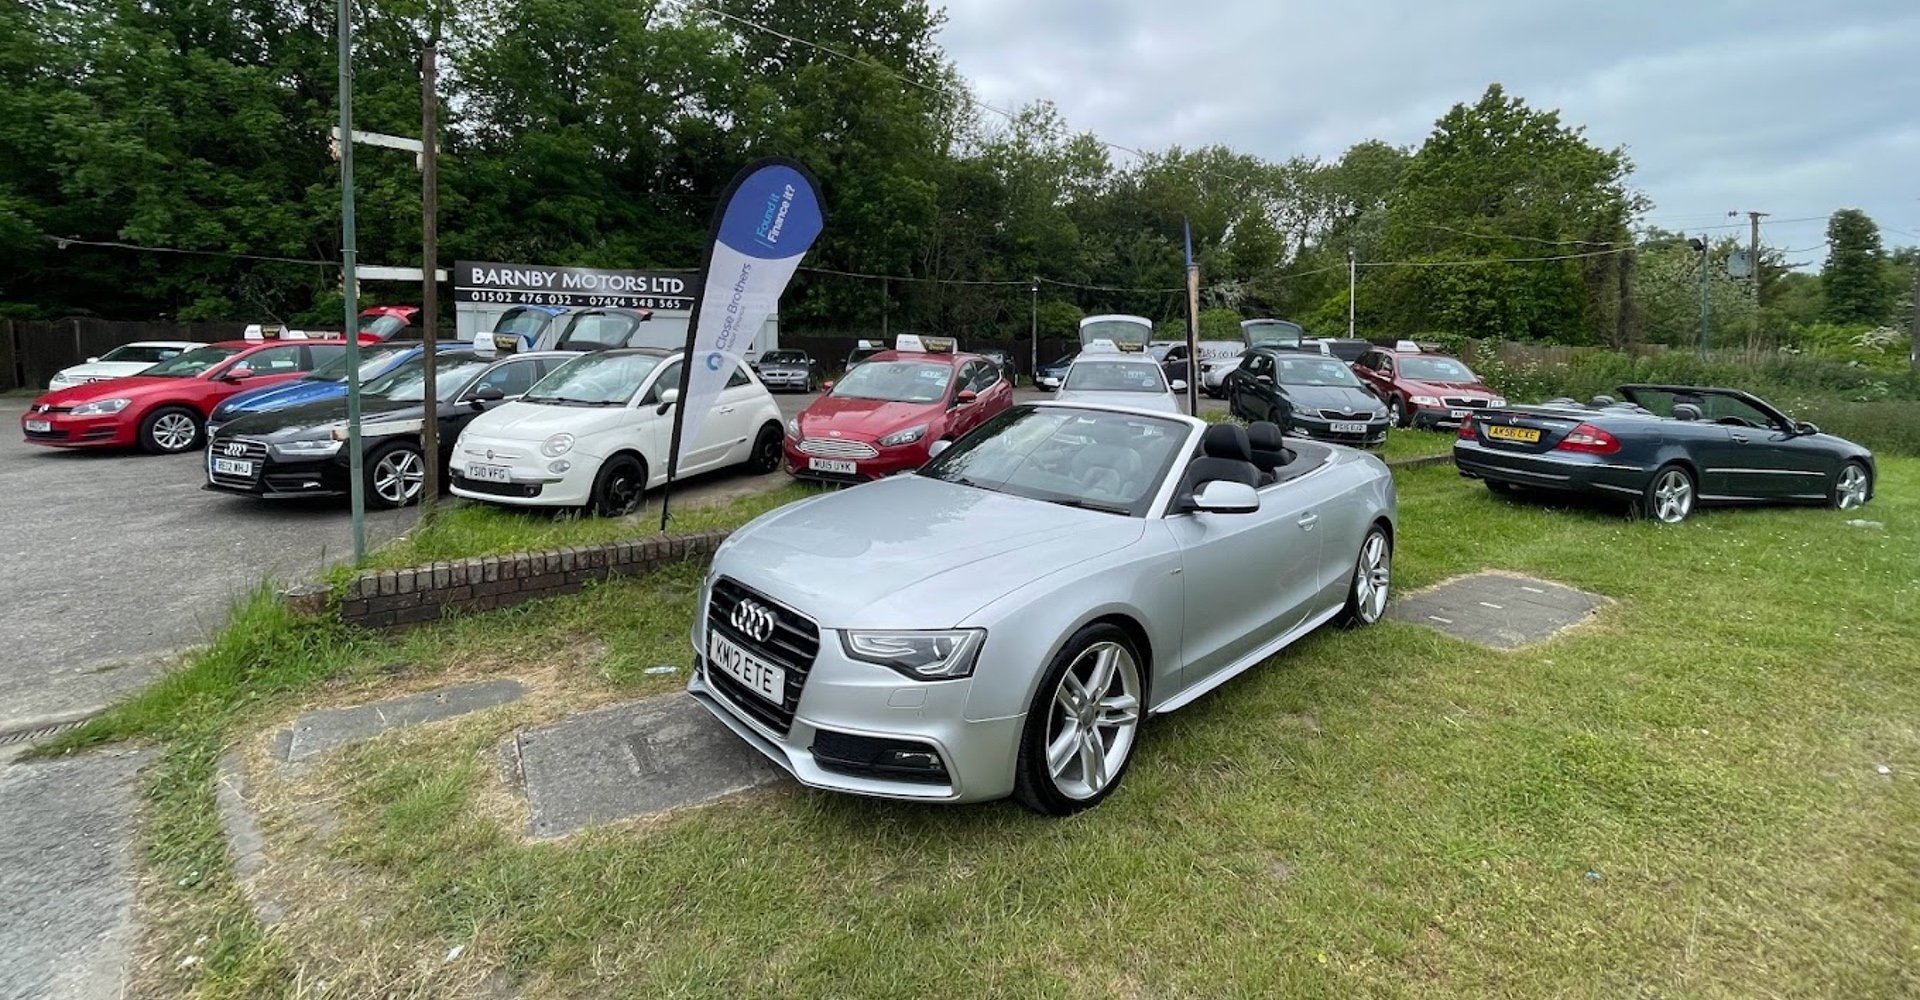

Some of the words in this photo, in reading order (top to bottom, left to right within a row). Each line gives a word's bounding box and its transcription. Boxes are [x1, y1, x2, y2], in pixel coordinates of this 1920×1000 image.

[756, 201, 776, 237] Found
[769, 193, 780, 202] it
[767, 201, 790, 243] Finance
[782, 184, 796, 201] it?
[471, 267, 557, 287] BARNBY
[562, 272, 648, 292] MOTORS
[652, 277, 685, 294] LTD
[471, 291, 512, 303] 01502
[519, 293, 543, 304] 476
[549, 294, 572, 305] 032
[589, 296, 626, 307] 07474
[632, 298, 653, 308] 548
[659, 299, 681, 309] 565
[715, 316, 735, 350] Close
[727, 263, 752, 314] Brothers
[469, 465, 487, 478] YS10
[488, 466, 505, 479] VFG
[716, 637, 741, 675] KM12
[743, 656, 773, 695] ETE
